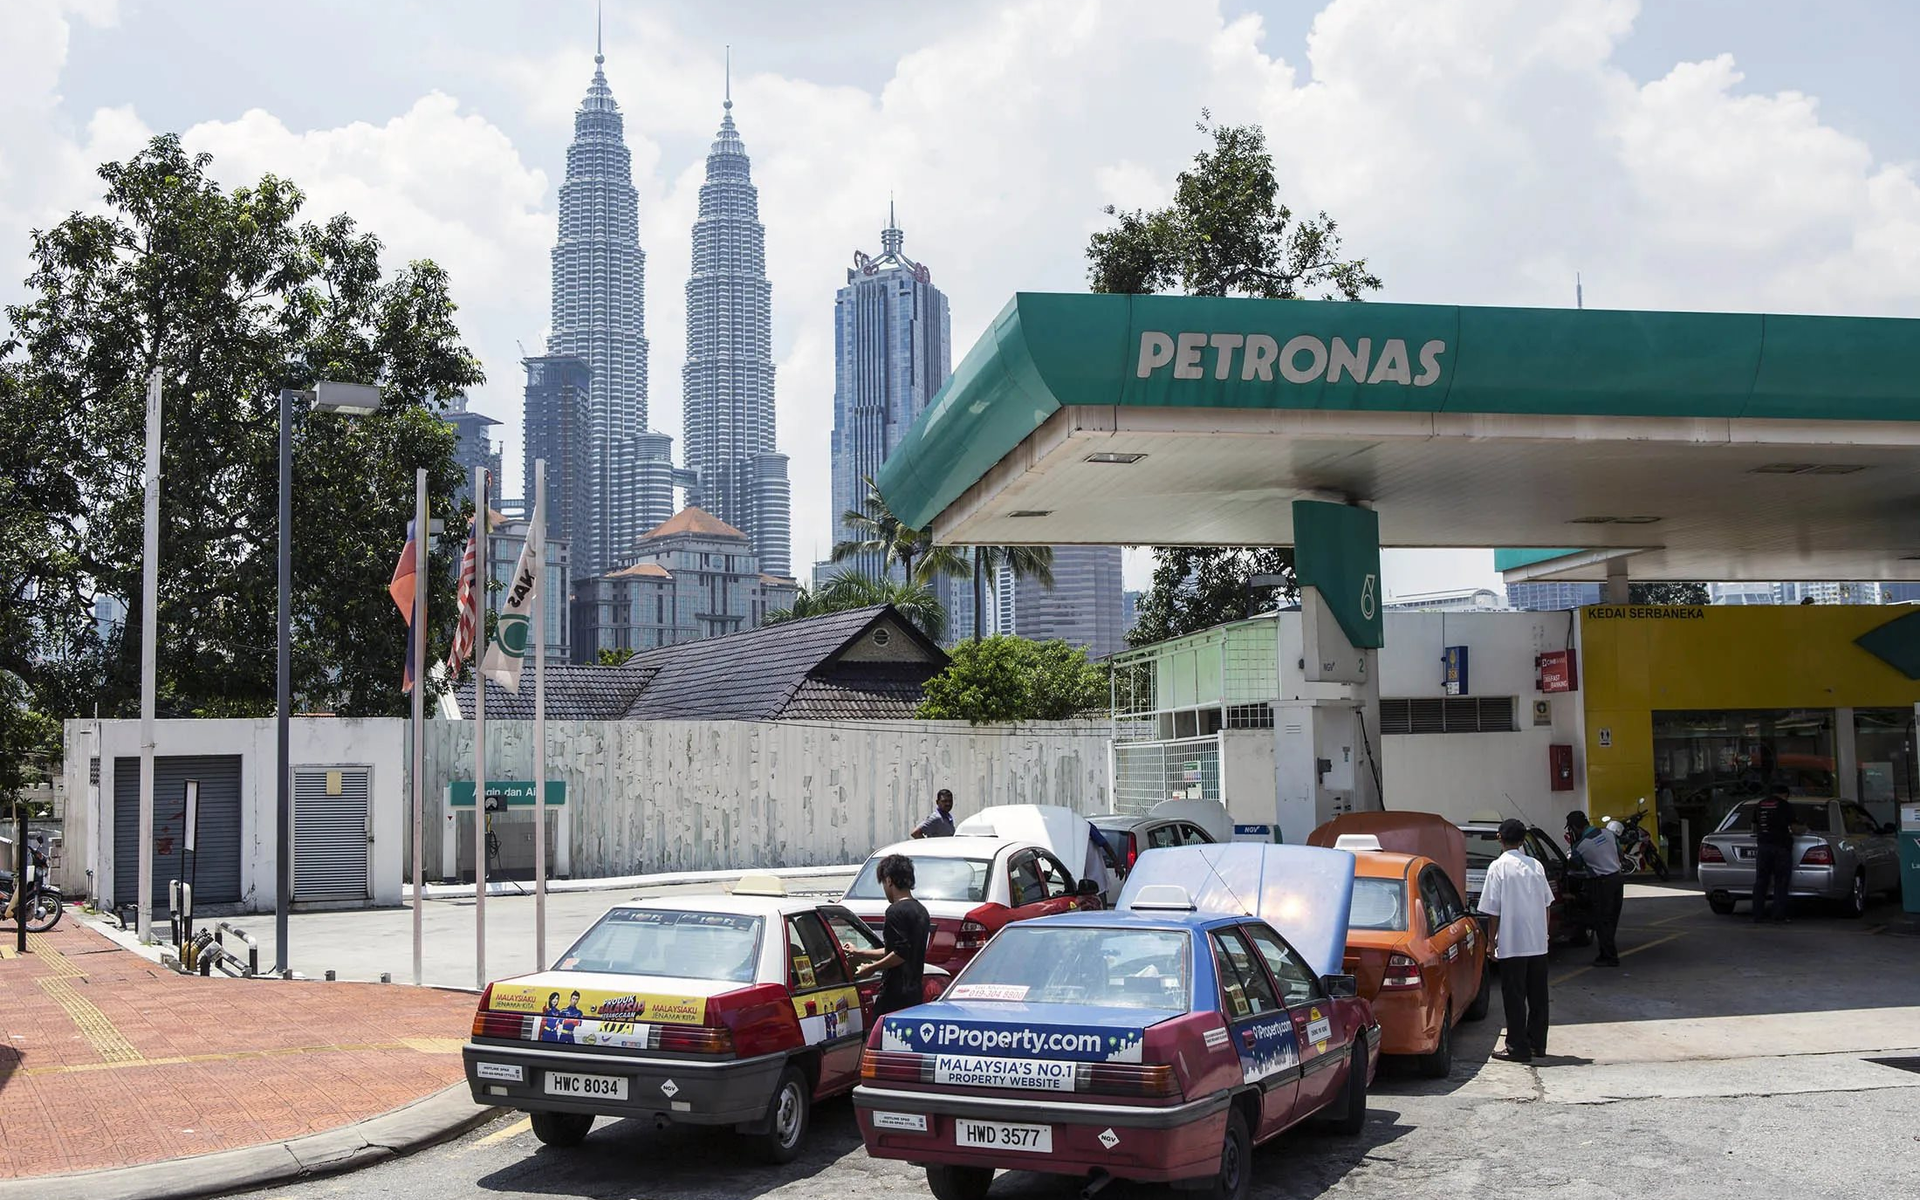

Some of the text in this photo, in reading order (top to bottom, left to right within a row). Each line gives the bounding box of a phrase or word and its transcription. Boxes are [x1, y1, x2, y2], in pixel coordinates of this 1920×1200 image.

[1136, 331, 1446, 387] PETRONAS
[1588, 607, 1705, 619] KEDAI SERBANEKA
[1358, 657, 1364, 674] 2
[504, 787, 522, 797] dan
[1244, 825, 1260, 833] NGV
[495, 993, 537, 1004] MALAYSIAKU
[603, 995, 636, 1005] PRODUK
[651, 1004, 698, 1014] MALAYSIAKU
[598, 1022, 634, 1035] KITA
[1257, 1020, 1293, 1040] iProperty.com
[938, 1025, 1101, 1054] iProperty.com
[939, 1057, 1073, 1078] MALAYSIA'S NO.1
[554, 1075, 618, 1095] HWC 8034
[948, 1074, 1060, 1089] PROPERTY WEBSITE
[967, 1124, 1040, 1147] HWD 3577
[1100, 1134, 1116, 1143] NGV
